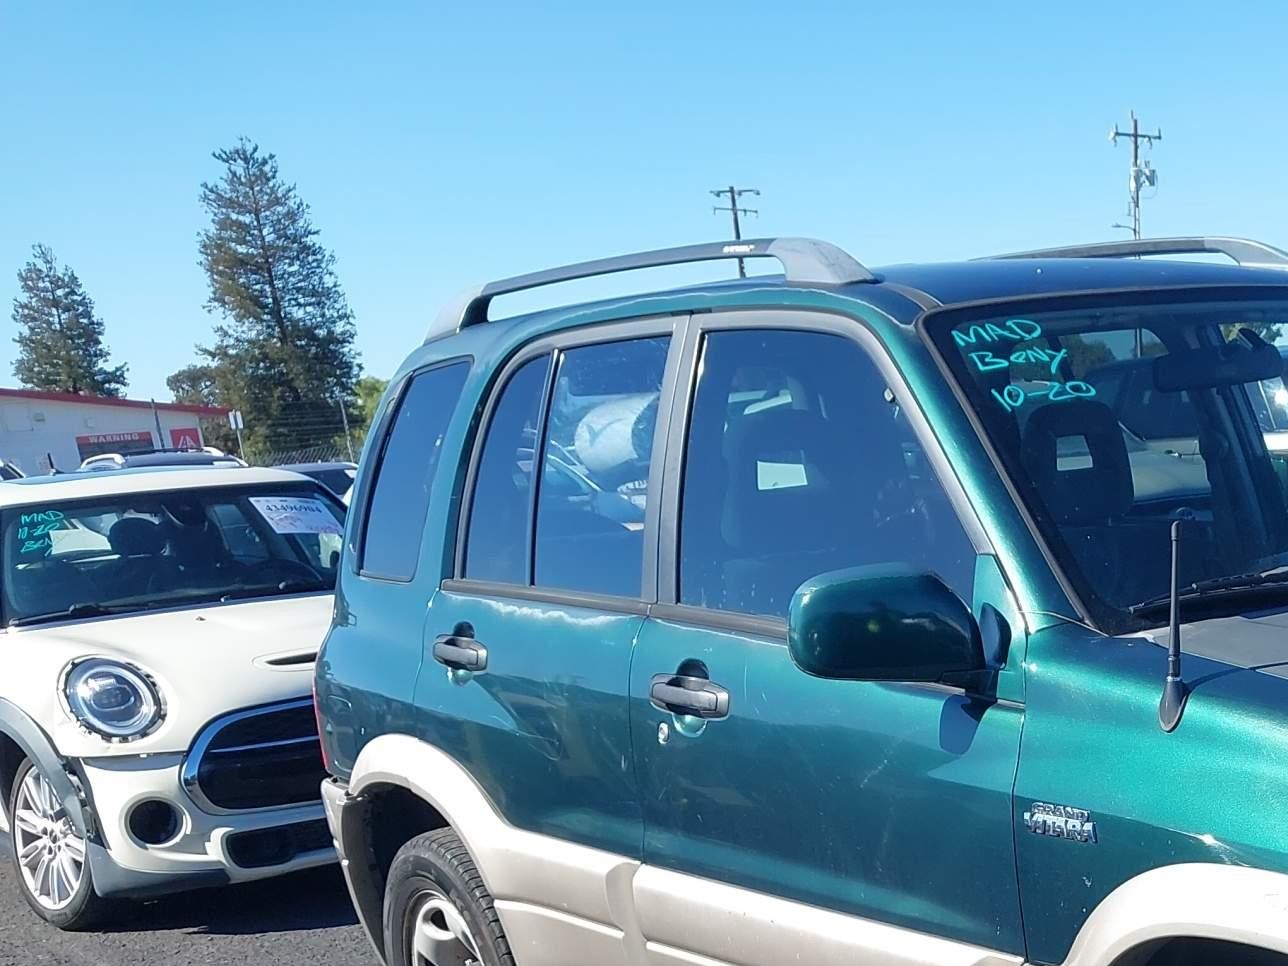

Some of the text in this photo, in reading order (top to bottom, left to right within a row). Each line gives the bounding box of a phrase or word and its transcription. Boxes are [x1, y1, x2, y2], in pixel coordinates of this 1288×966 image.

[951, 319, 1042, 346] MAD
[990, 380, 1097, 412] 10-20
[88, 432, 139, 443] WARNING
[21, 510, 65, 525] MAD
[1031, 802, 1091, 821] GRAND
[1023, 811, 1098, 843] VITARA
